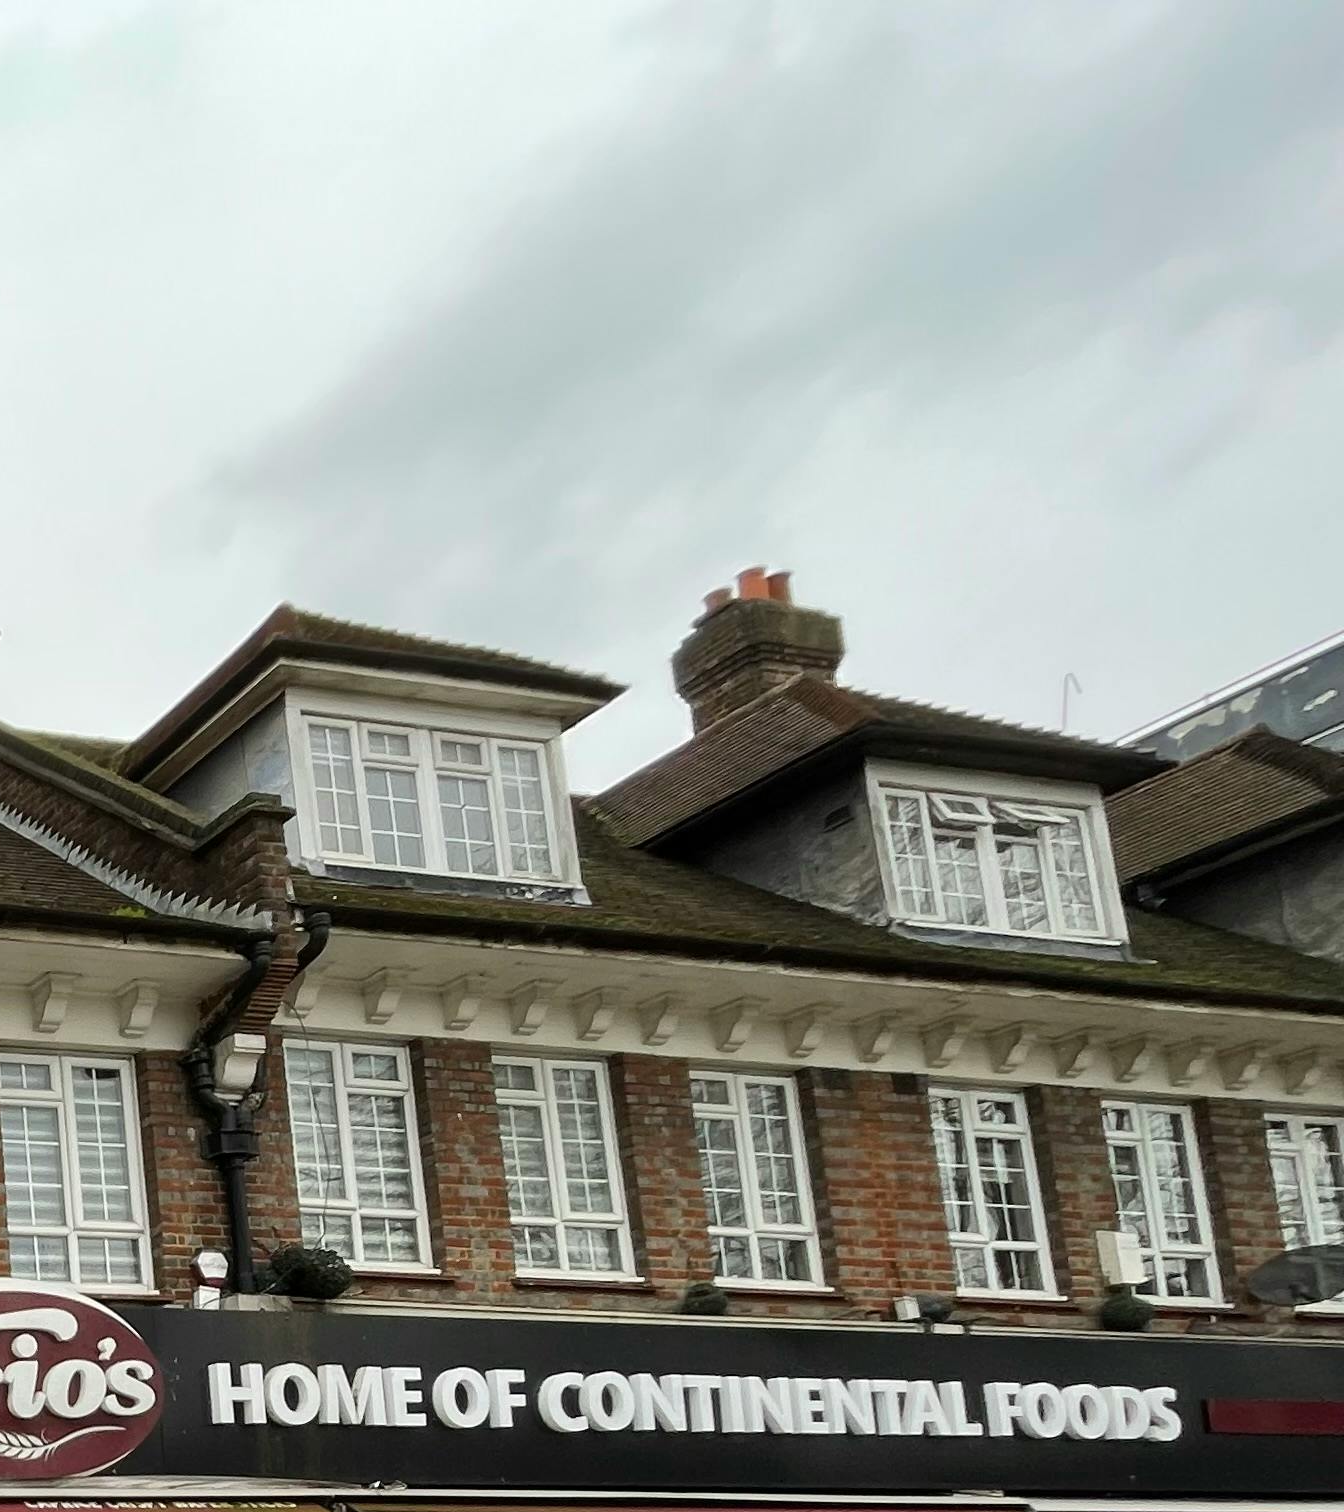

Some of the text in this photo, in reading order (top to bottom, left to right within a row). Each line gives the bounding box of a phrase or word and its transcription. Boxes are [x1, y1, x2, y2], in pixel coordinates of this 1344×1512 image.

[208, 1362, 1183, 1442] HOME OF CONTINENTAL FOODS
